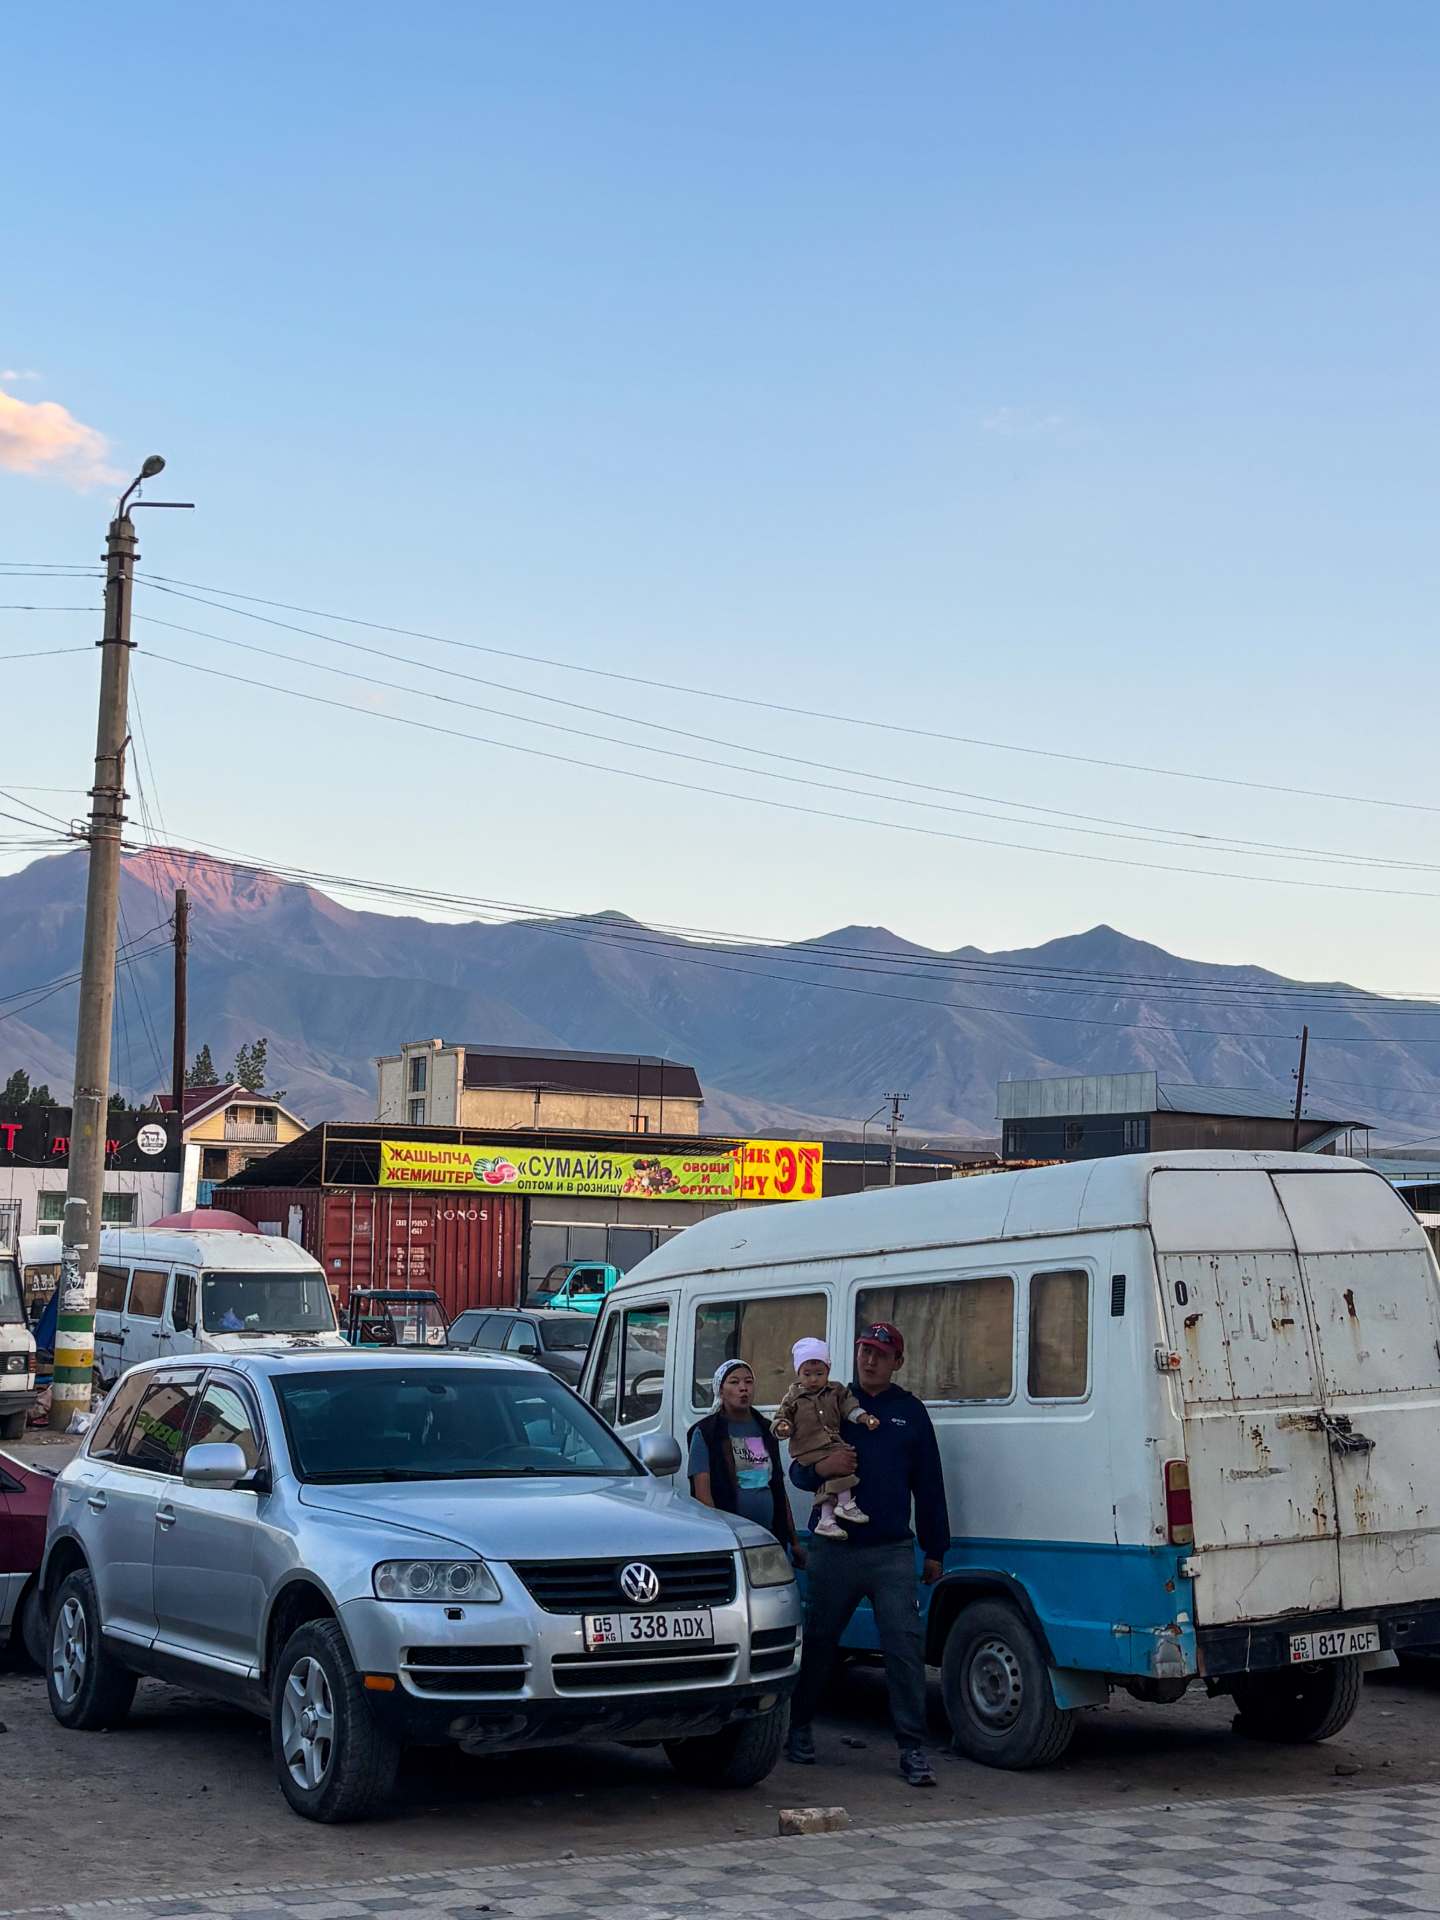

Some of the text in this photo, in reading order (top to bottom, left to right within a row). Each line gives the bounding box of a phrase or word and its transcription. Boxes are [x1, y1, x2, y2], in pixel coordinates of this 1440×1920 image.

[389, 1148, 473, 1166] ЖАШЫЛЧА
[386, 1166, 474, 1184] ЖЕМИШТЕР
[517, 1154, 622, 1181] «СУМАЙЯ»
[682, 1162, 730, 1174] ОВОЩИ
[775, 1147, 820, 1195] ЭТ
[701, 1174, 710, 1183] И
[679, 1184, 733, 1196] ФРУКТЫ
[593, 1615, 705, 1640] 05 338 ADX
[605, 1632, 616, 1642] KG
[1293, 1631, 1375, 1656] 05 817 ACF
[1301, 1650, 1310, 1659] KG
